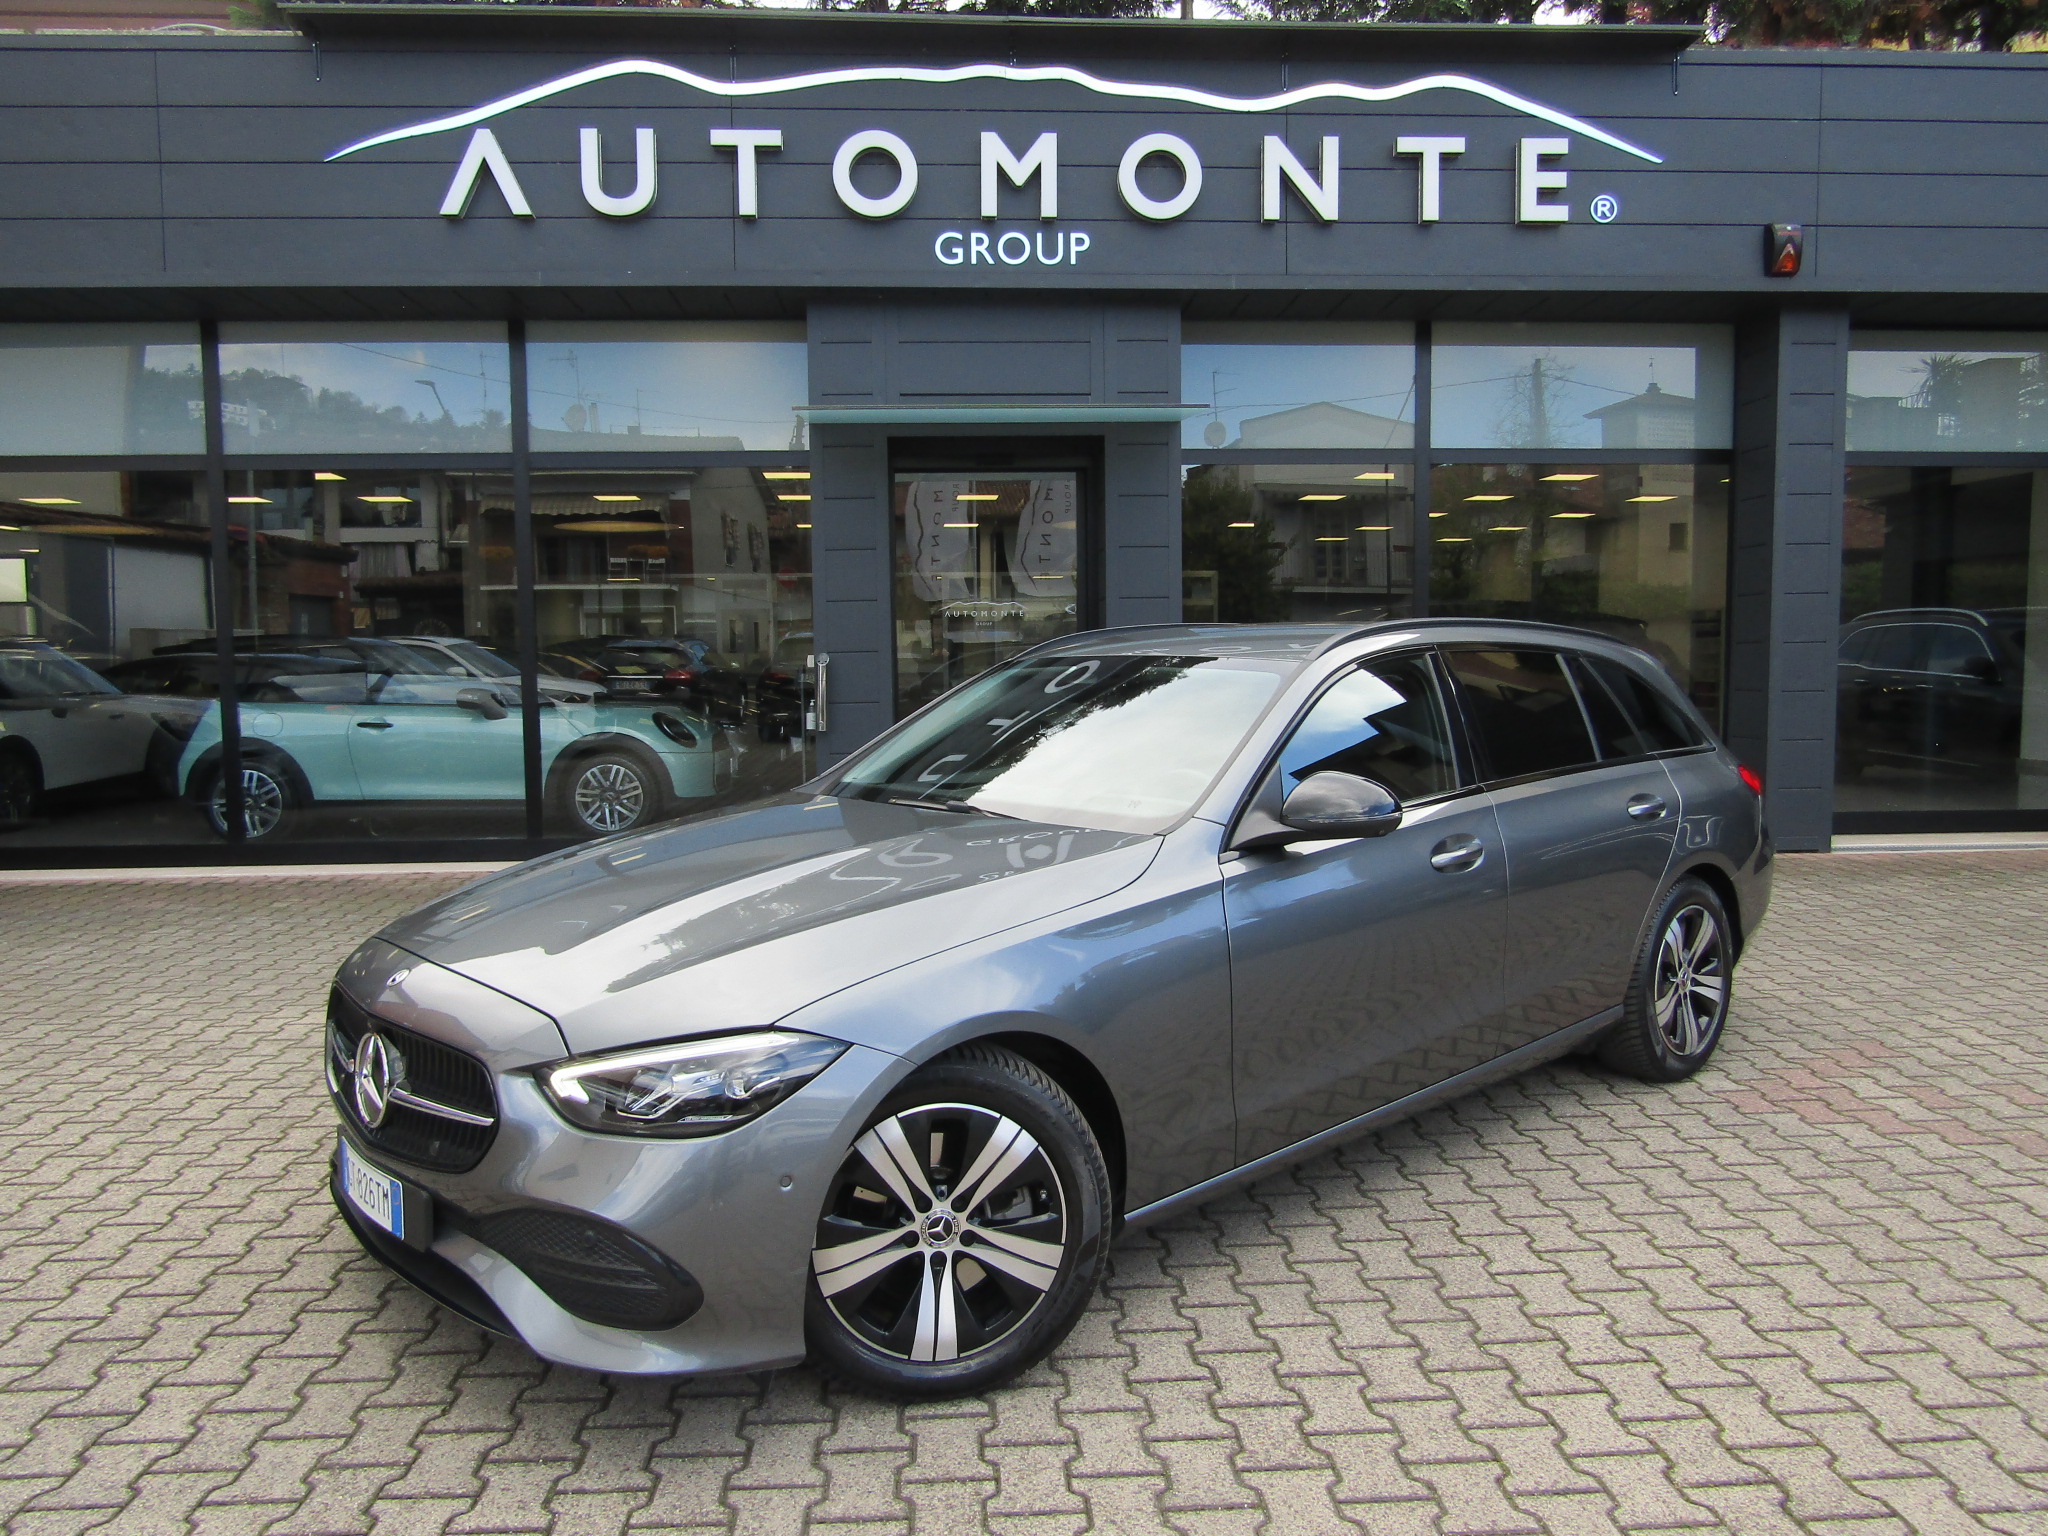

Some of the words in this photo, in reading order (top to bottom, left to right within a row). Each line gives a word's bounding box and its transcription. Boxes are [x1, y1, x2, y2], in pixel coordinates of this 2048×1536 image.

[438, 127, 1570, 222] AUTOMONTE
[934, 231, 1091, 265] GROUP
[944, 609, 1024, 618] AUTOMONTE
